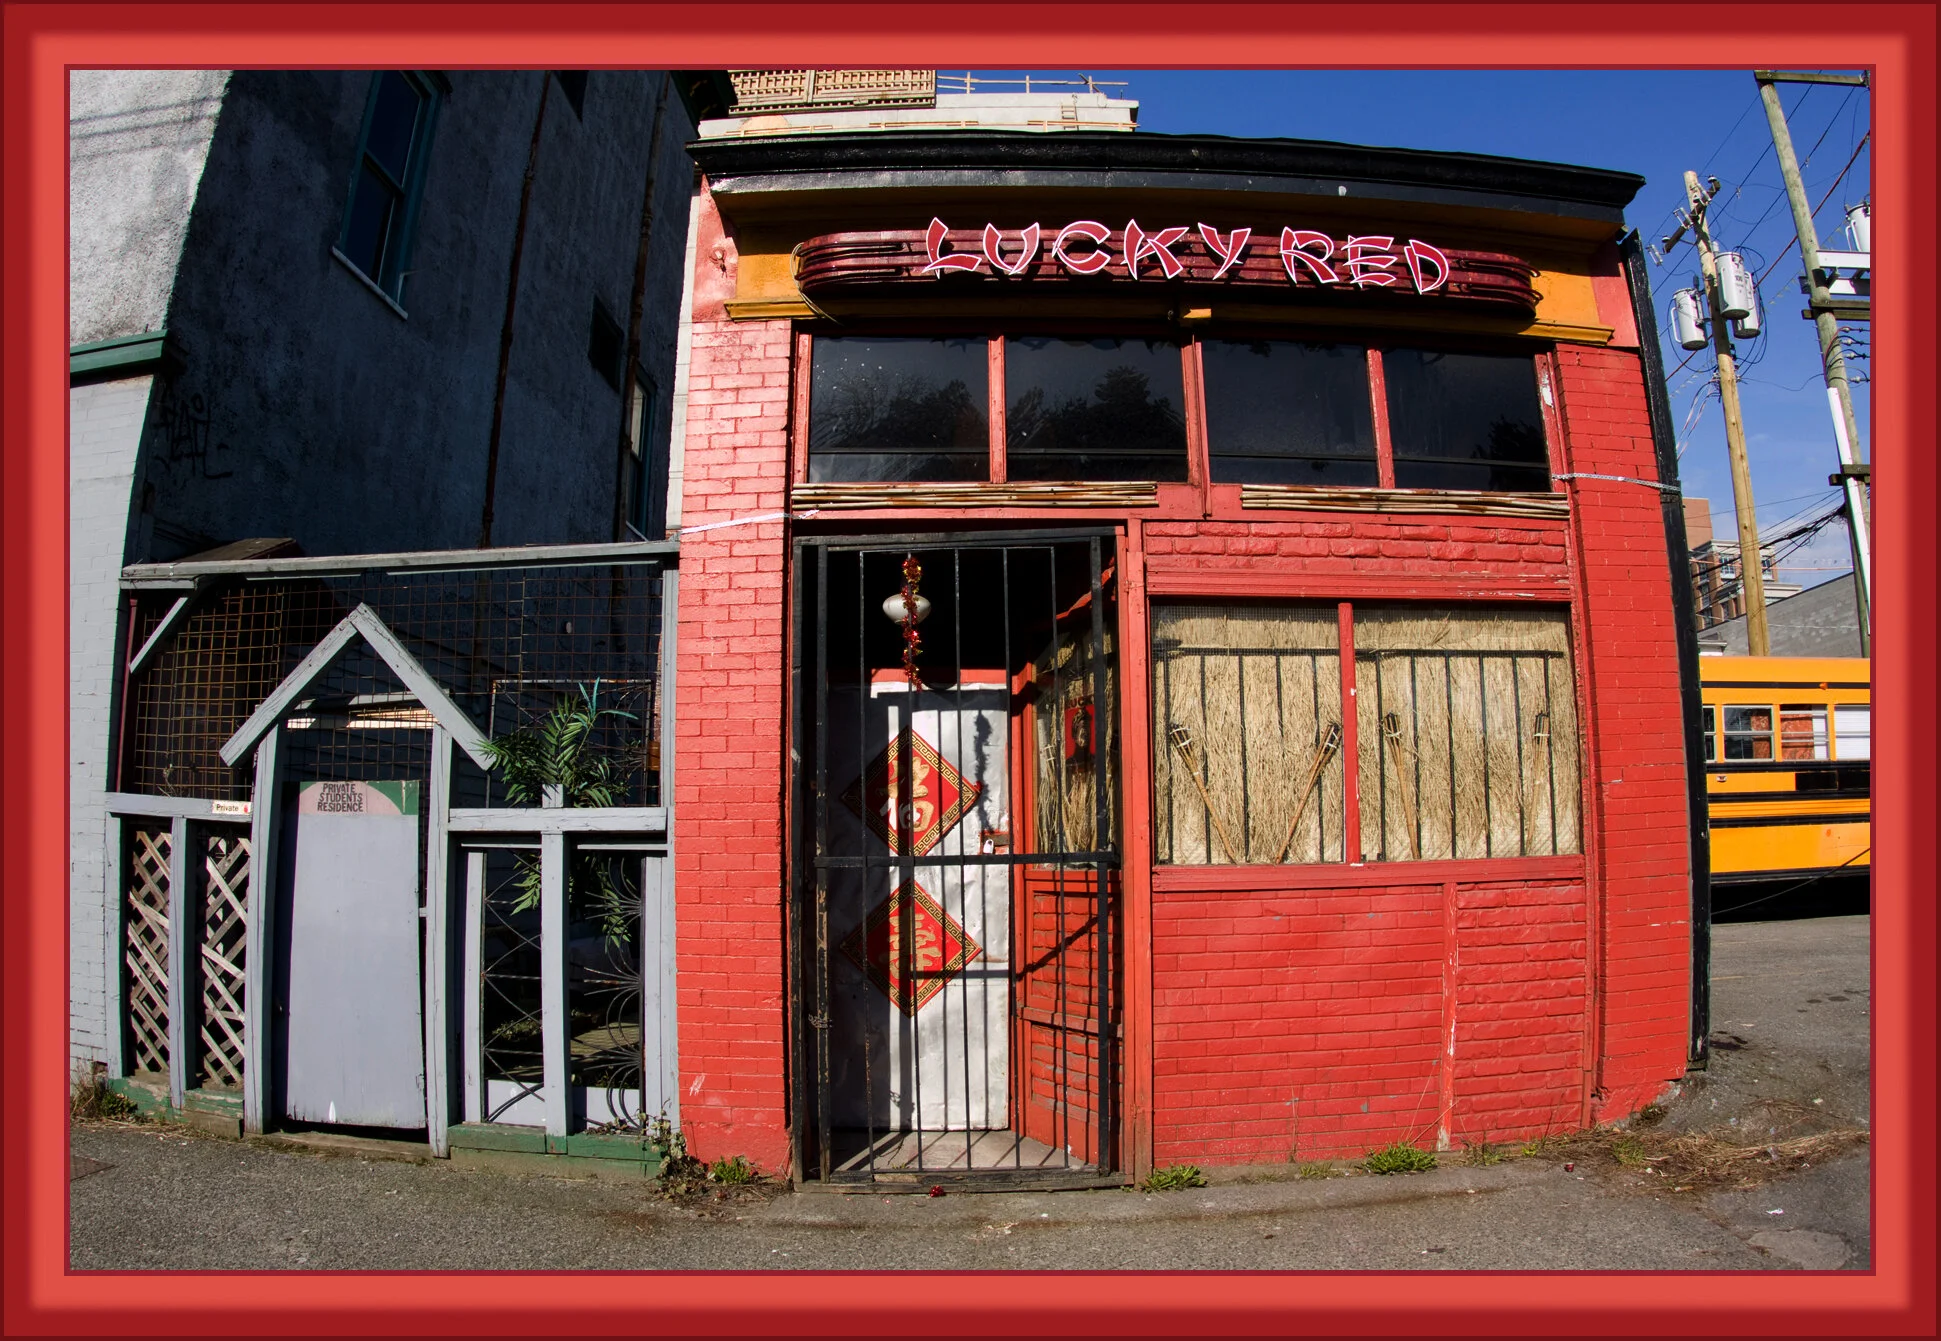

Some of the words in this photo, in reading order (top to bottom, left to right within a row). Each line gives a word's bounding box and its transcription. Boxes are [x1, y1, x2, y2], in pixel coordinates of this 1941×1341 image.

[921, 216, 1252, 281] LUCKY
[1279, 226, 1450, 295] RED
[322, 783, 356, 794] PRIVATE
[319, 792, 363, 802] STUDENTS
[216, 803, 239, 812] Private
[317, 801, 364, 812] RESIDENCE
